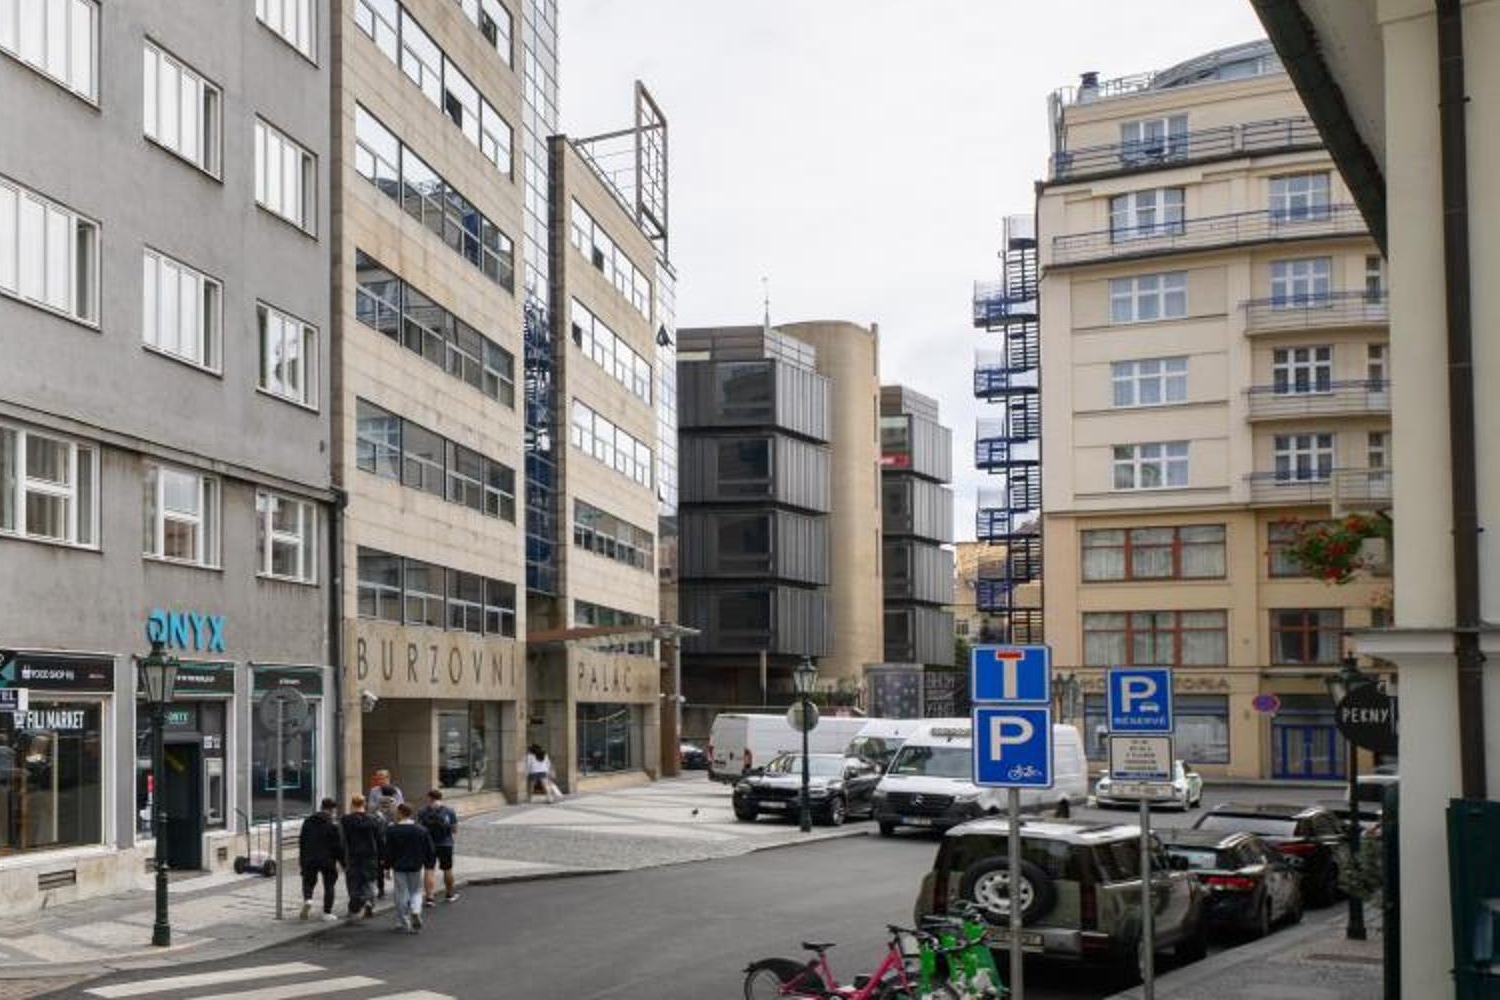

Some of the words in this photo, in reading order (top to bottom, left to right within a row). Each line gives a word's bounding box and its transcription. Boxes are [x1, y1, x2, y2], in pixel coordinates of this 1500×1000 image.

[147, 609, 226, 653] ONYX
[27, 710, 45, 729] FILI
[46, 710, 84, 729] MARKET
